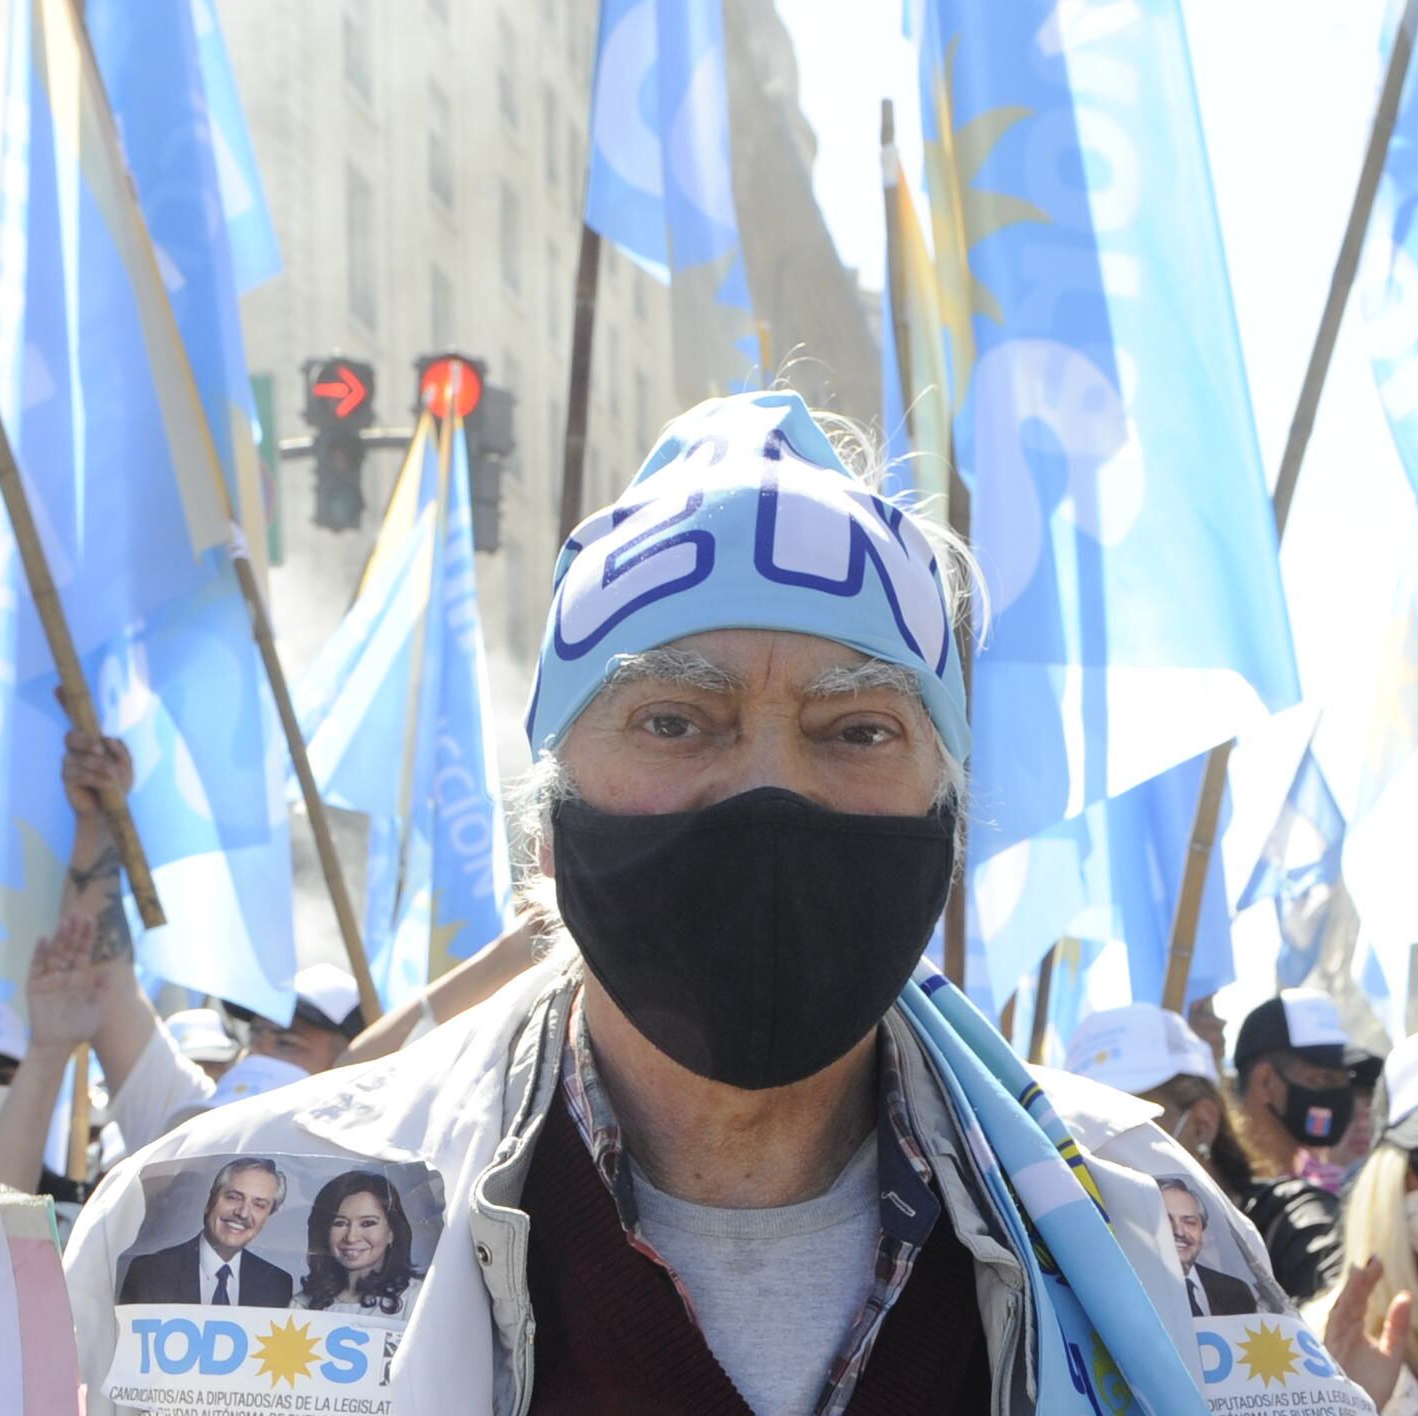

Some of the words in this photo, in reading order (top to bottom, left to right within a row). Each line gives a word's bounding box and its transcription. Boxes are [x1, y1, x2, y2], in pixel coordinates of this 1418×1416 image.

[109, 1386, 194, 1405] CANDIDATOS/AS
[196, 1392, 206, 1405] A
[207, 1391, 292, 1410] DIPUTADOS/AS
[295, 1394, 312, 1411] DE
[314, 1396, 331, 1413] LA
